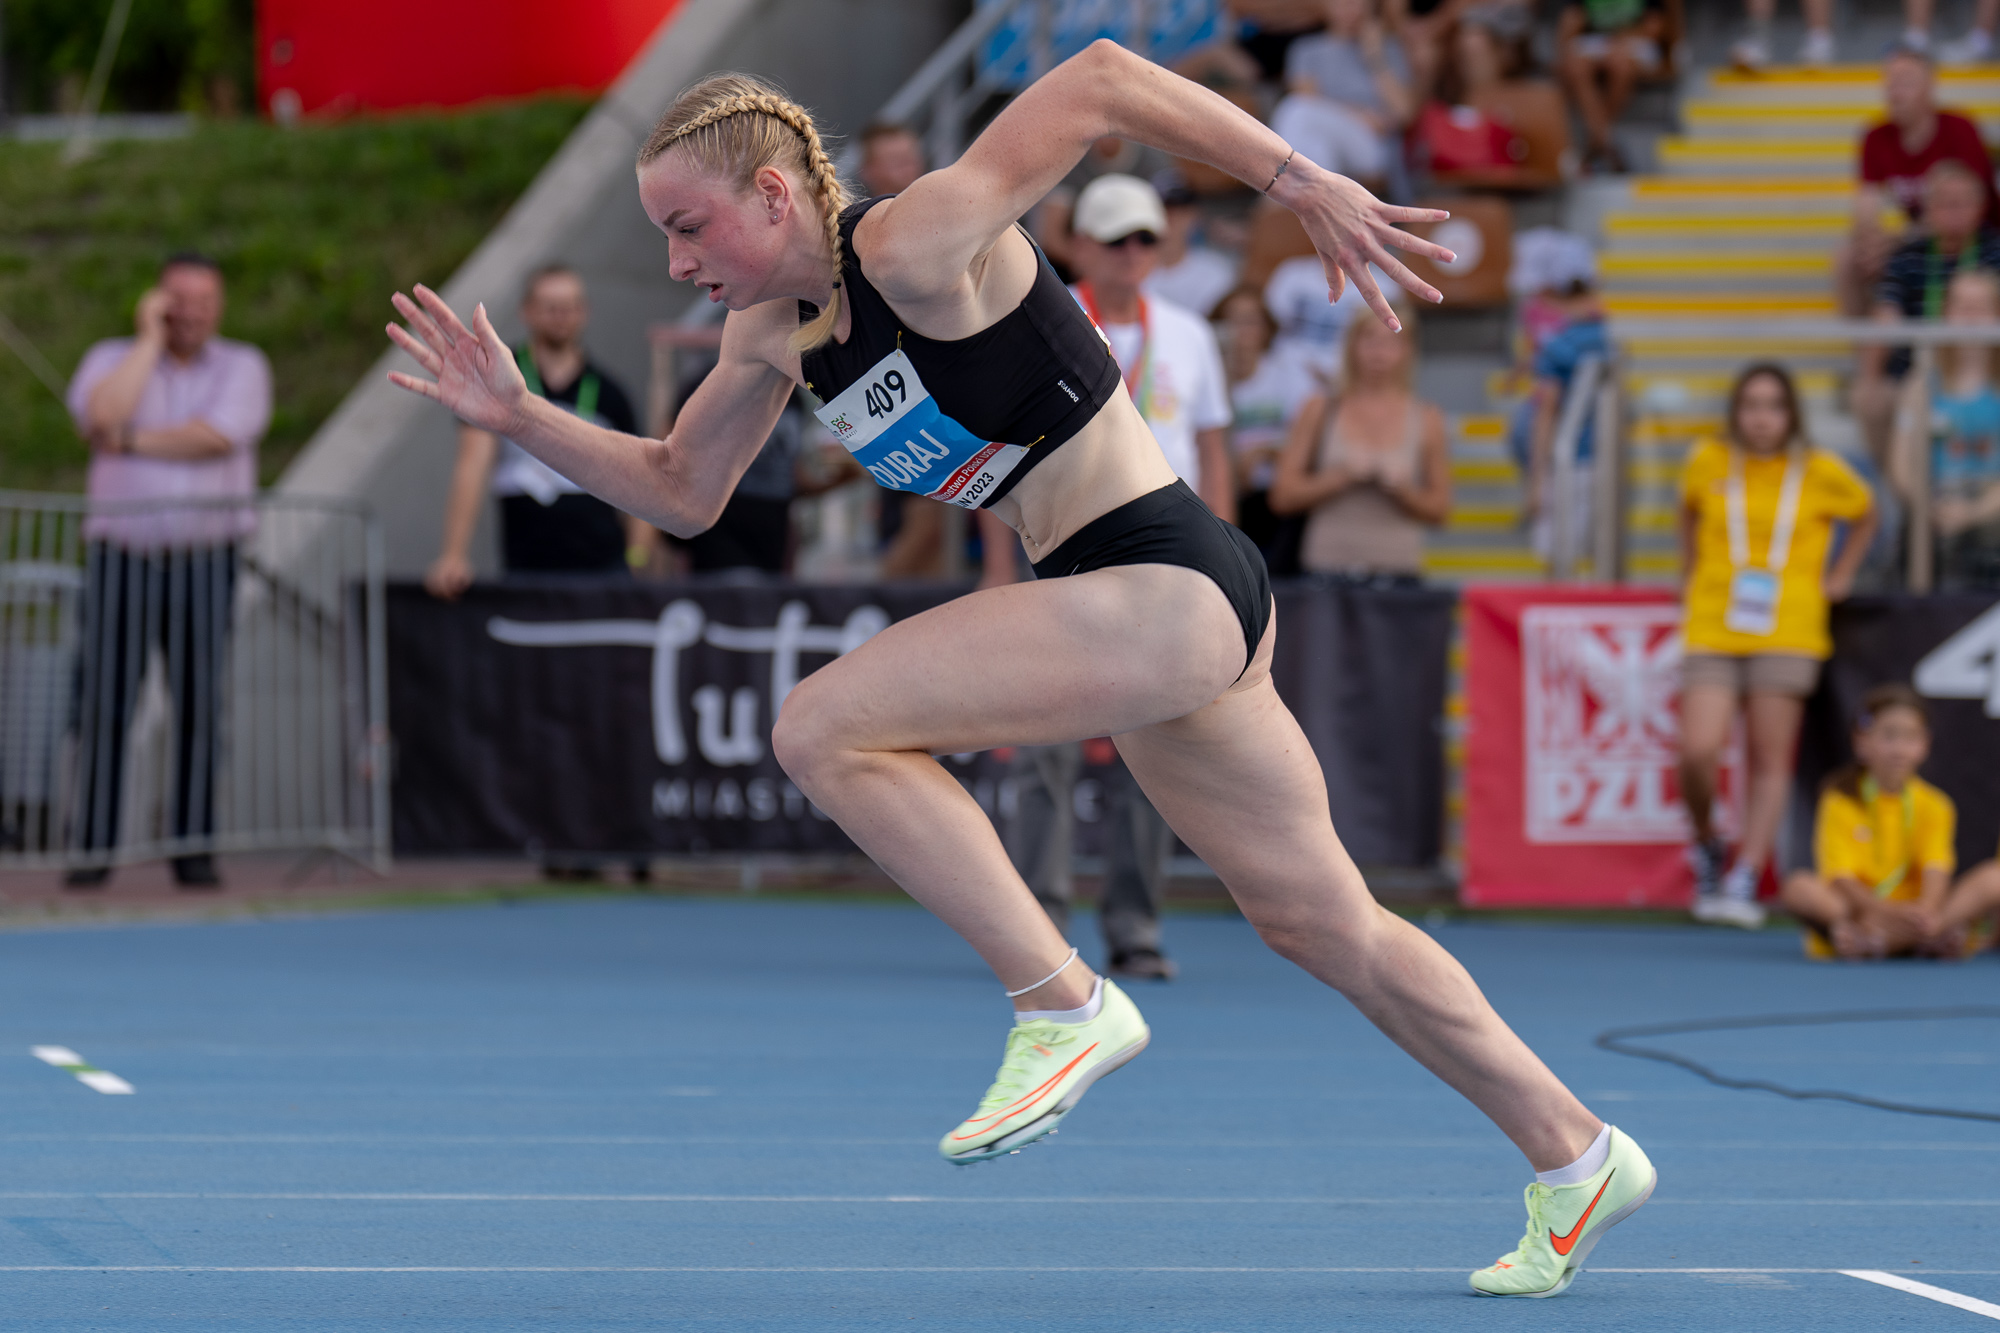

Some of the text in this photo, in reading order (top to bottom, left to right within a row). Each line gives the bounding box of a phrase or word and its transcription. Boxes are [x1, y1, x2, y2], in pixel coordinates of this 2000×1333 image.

[865, 370, 906, 419] 409
[1057, 379, 1080, 403] DOMYOS
[866, 429, 950, 488] DURAJ
[965, 472, 994, 500] 2023
[651, 777, 838, 822] MIAST
